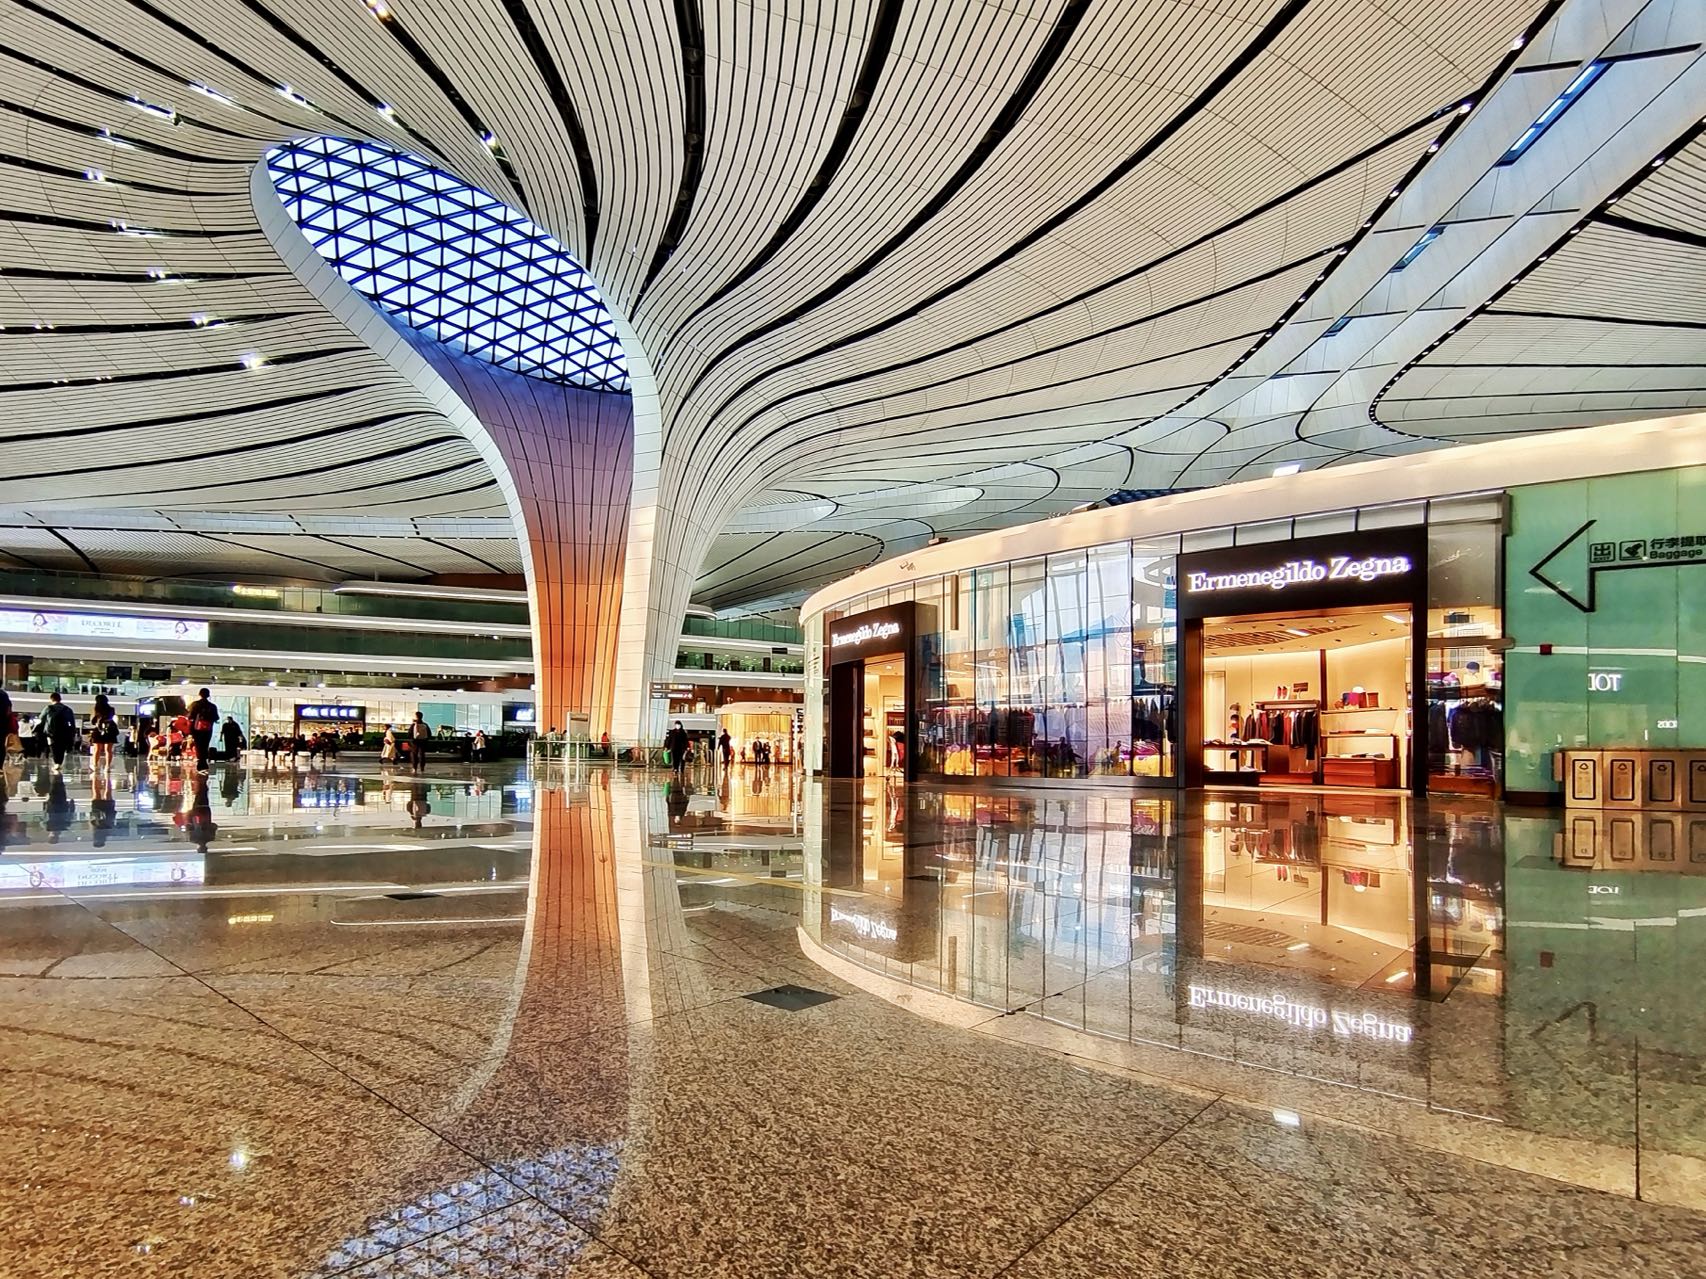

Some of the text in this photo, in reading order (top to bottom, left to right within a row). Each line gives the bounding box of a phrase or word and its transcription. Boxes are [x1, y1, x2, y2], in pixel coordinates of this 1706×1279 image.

[1650, 549, 1703, 559] Baggage
[1188, 556, 1412, 590] Ermenegildo Zegna
[872, 622, 900, 640] Zegna
